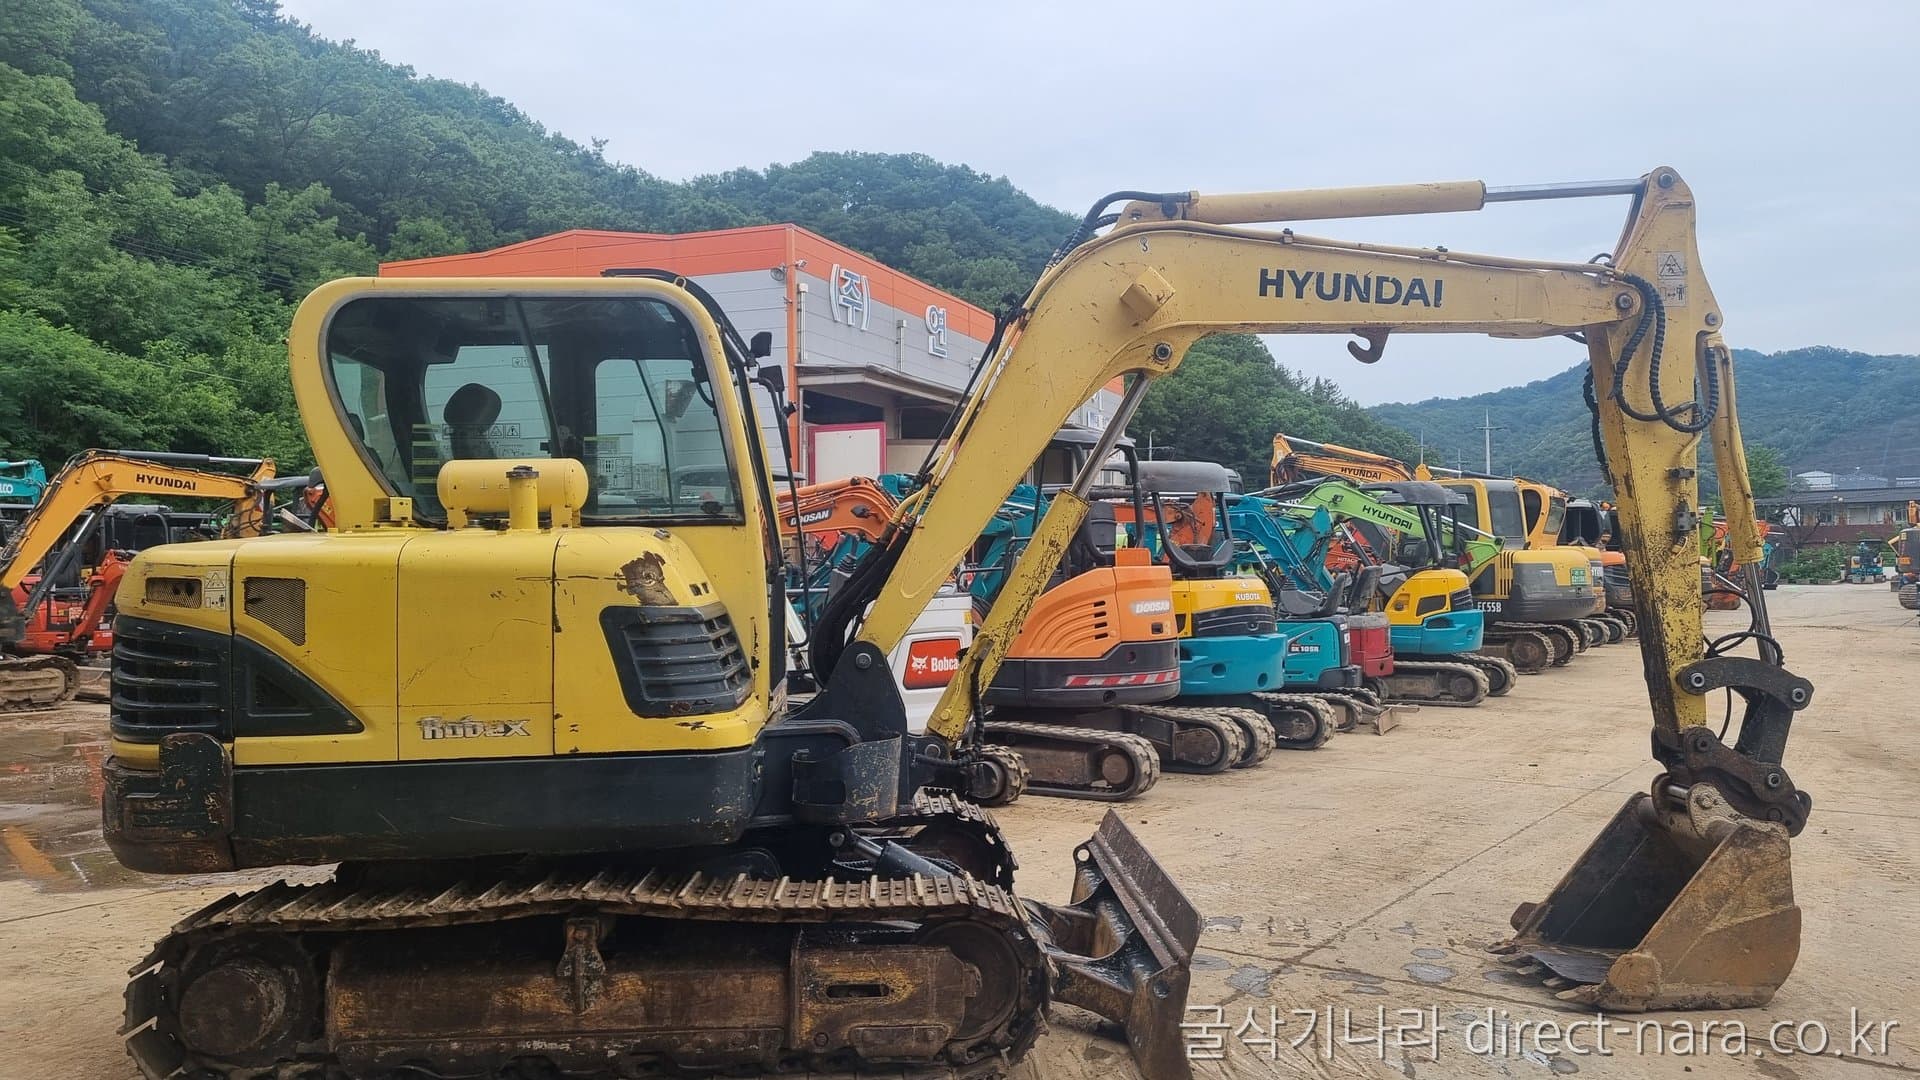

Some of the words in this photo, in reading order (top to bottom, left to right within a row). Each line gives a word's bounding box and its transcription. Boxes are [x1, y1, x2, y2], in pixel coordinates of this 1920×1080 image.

[1259, 268, 1443, 308] HYUNDAI
[829, 263, 871, 332] (주)
[925, 304, 948, 359] 연
[136, 473, 196, 491] HYUNDAI
[1341, 467, 1382, 480] HYUNDAI
[1362, 505, 1412, 530] HYUNDAI
[1235, 592, 1260, 601] KUBOTA
[1135, 601, 1170, 614] DOOSAN
[1477, 601, 1502, 613] EC55B
[930, 656, 960, 673] Bobca
